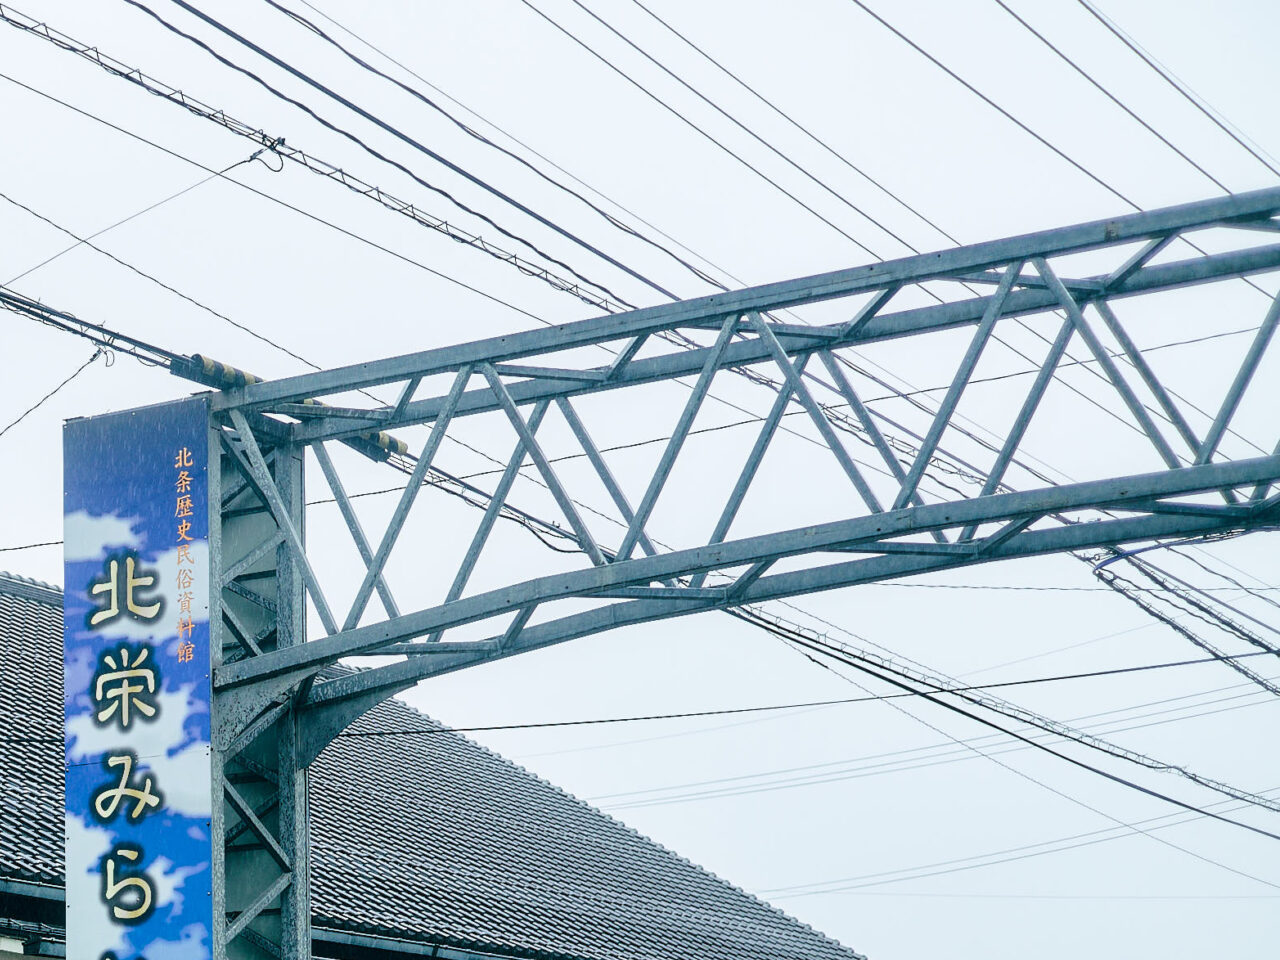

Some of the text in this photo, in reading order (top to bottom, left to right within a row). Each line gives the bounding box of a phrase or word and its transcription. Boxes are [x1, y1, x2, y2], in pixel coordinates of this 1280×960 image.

[174, 446, 195, 663] 北条歴史民俗資料館
